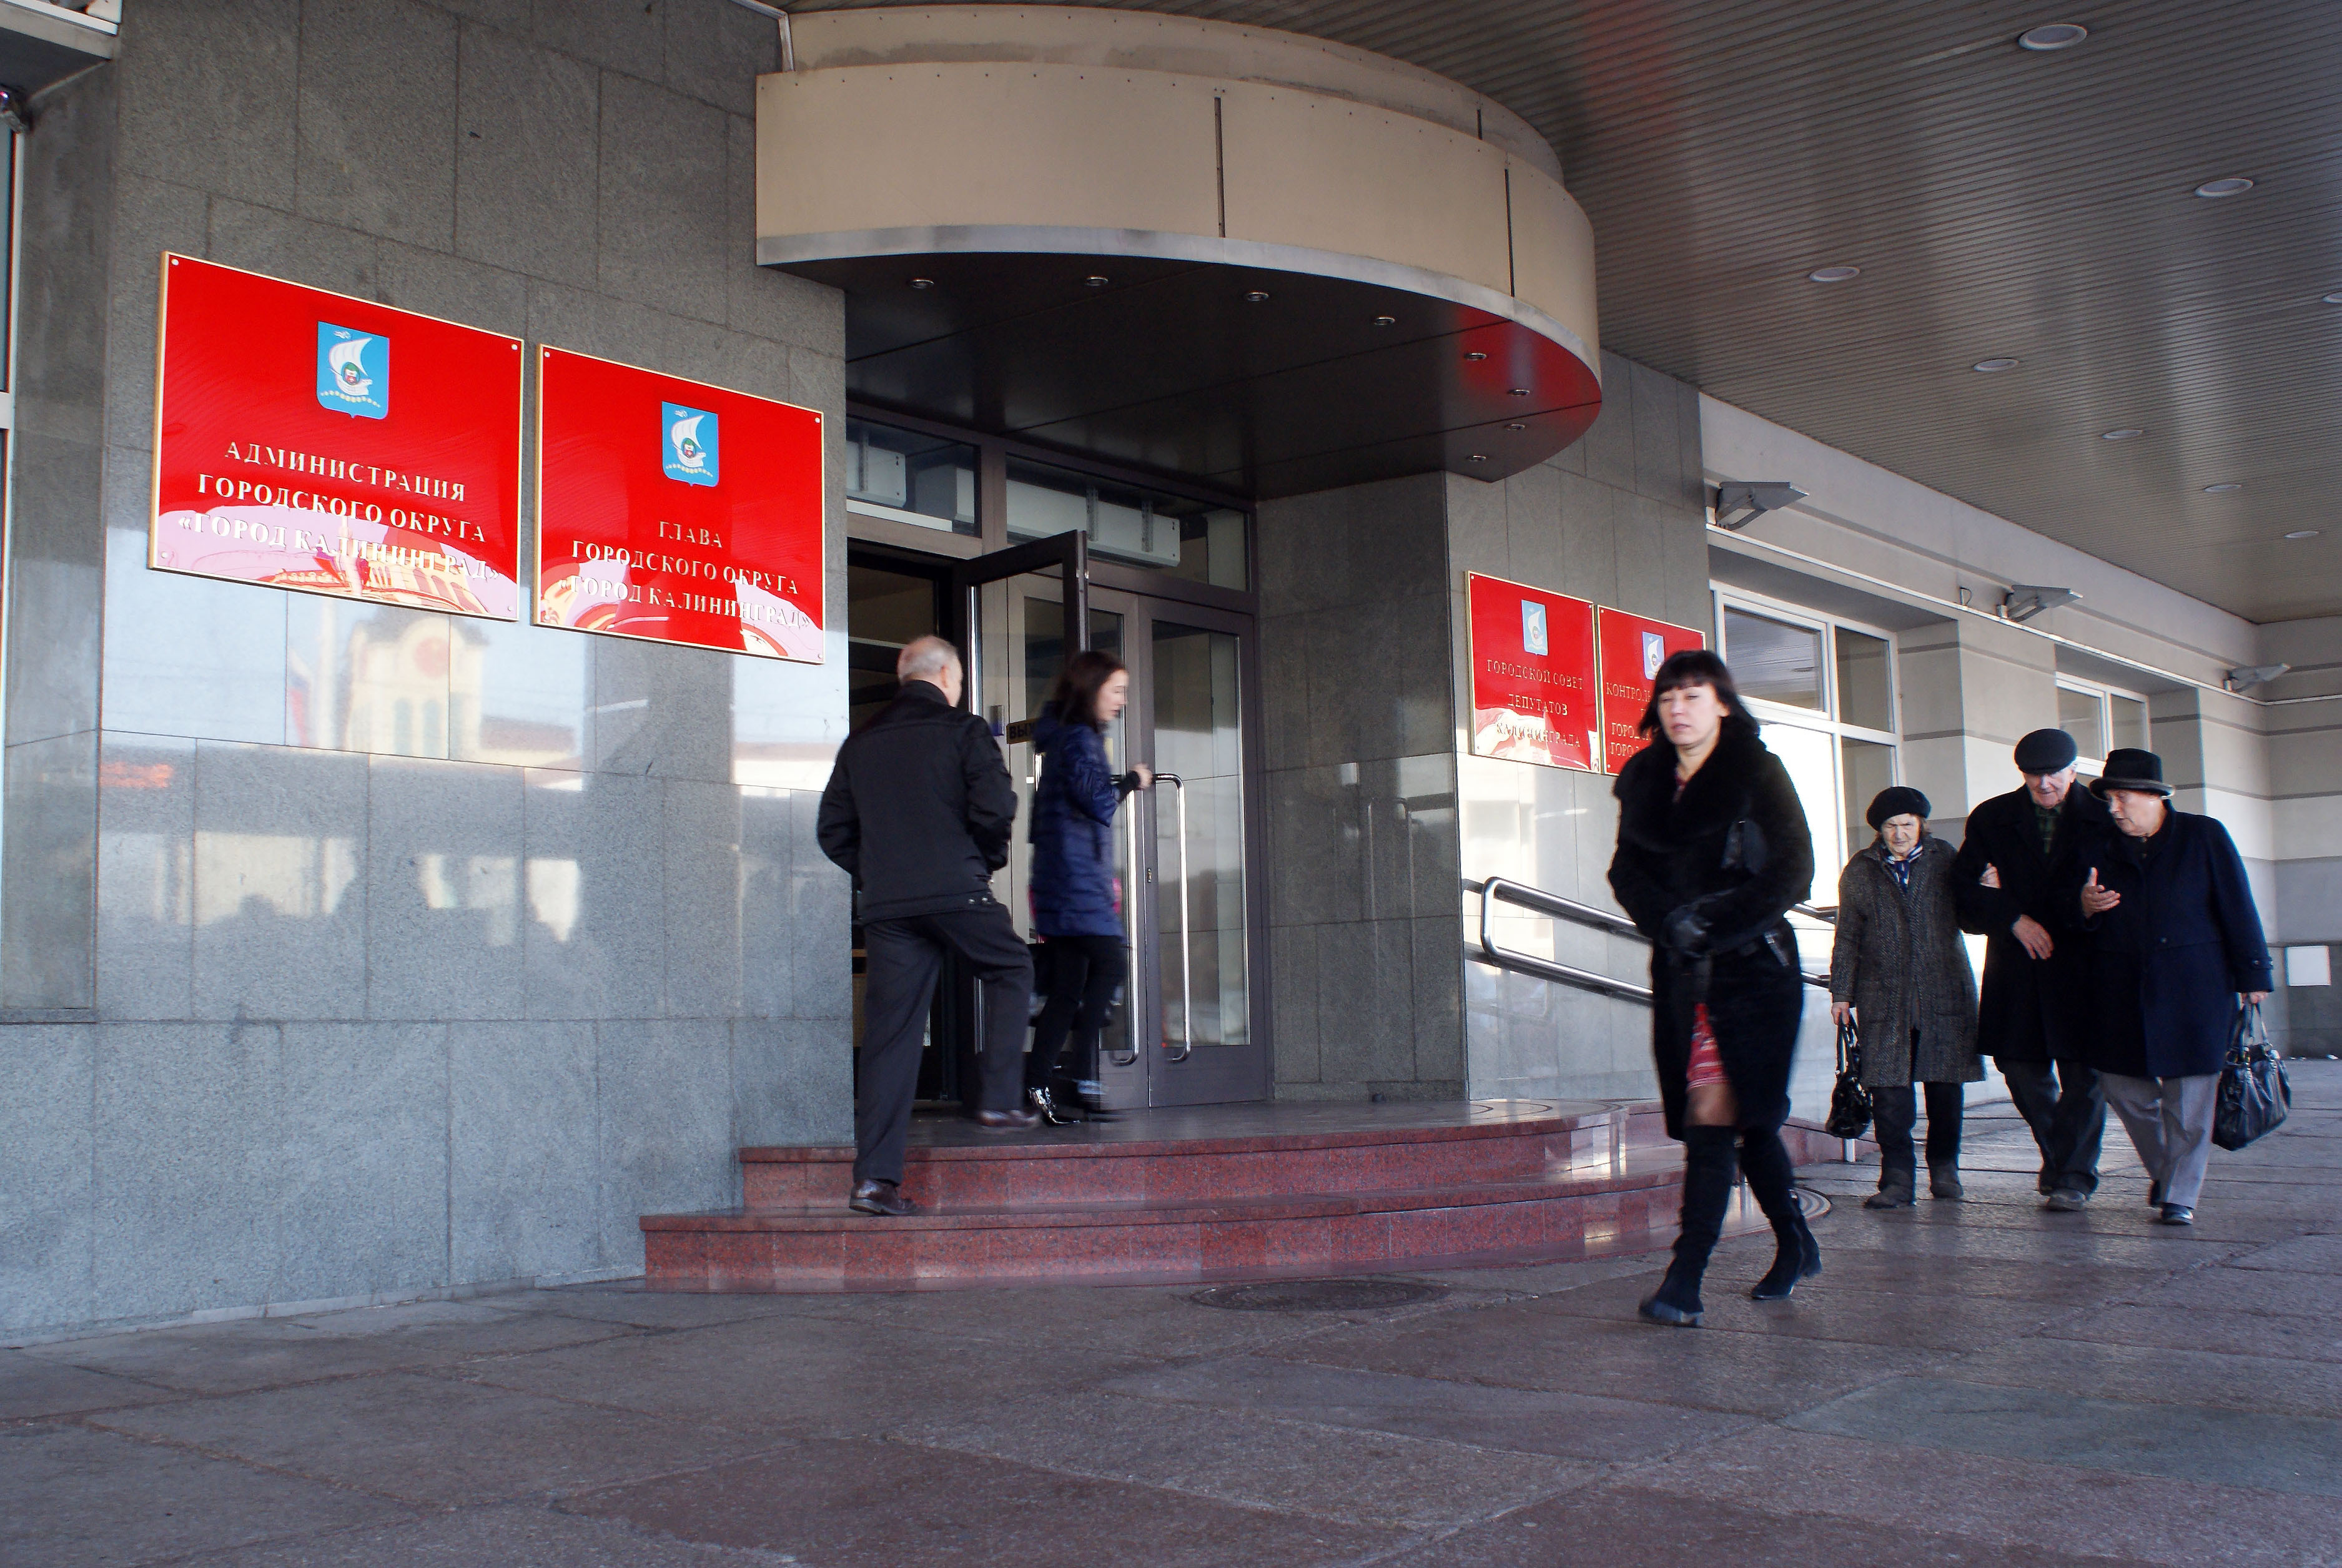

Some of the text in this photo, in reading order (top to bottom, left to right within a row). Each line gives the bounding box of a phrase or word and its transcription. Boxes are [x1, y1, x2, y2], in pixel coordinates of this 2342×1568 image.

[225, 441, 465, 501] АДМИНИСТРАЦИЯ
[198, 473, 486, 543] ГОРОДСКОГО ОКРУГА
[178, 513, 500, 580] «ГОРОД КАЛИНИНГРАД»
[659, 521, 723, 548] ГЛАВА
[571, 540, 798, 594] ГОРОДСКОГО ОКРУГА
[560, 574, 810, 629] «ГОРОД КАЛИНИНГРАД»
[1487, 659, 1583, 690] ГОРОДСКОЙ СОВЕТ
[1508, 694, 1568, 716] ДЕПУТАТОВ
[1009, 722, 1035, 740] ВЫХ
[1496, 722, 1581, 747] КАЛИНИНГРАДА
